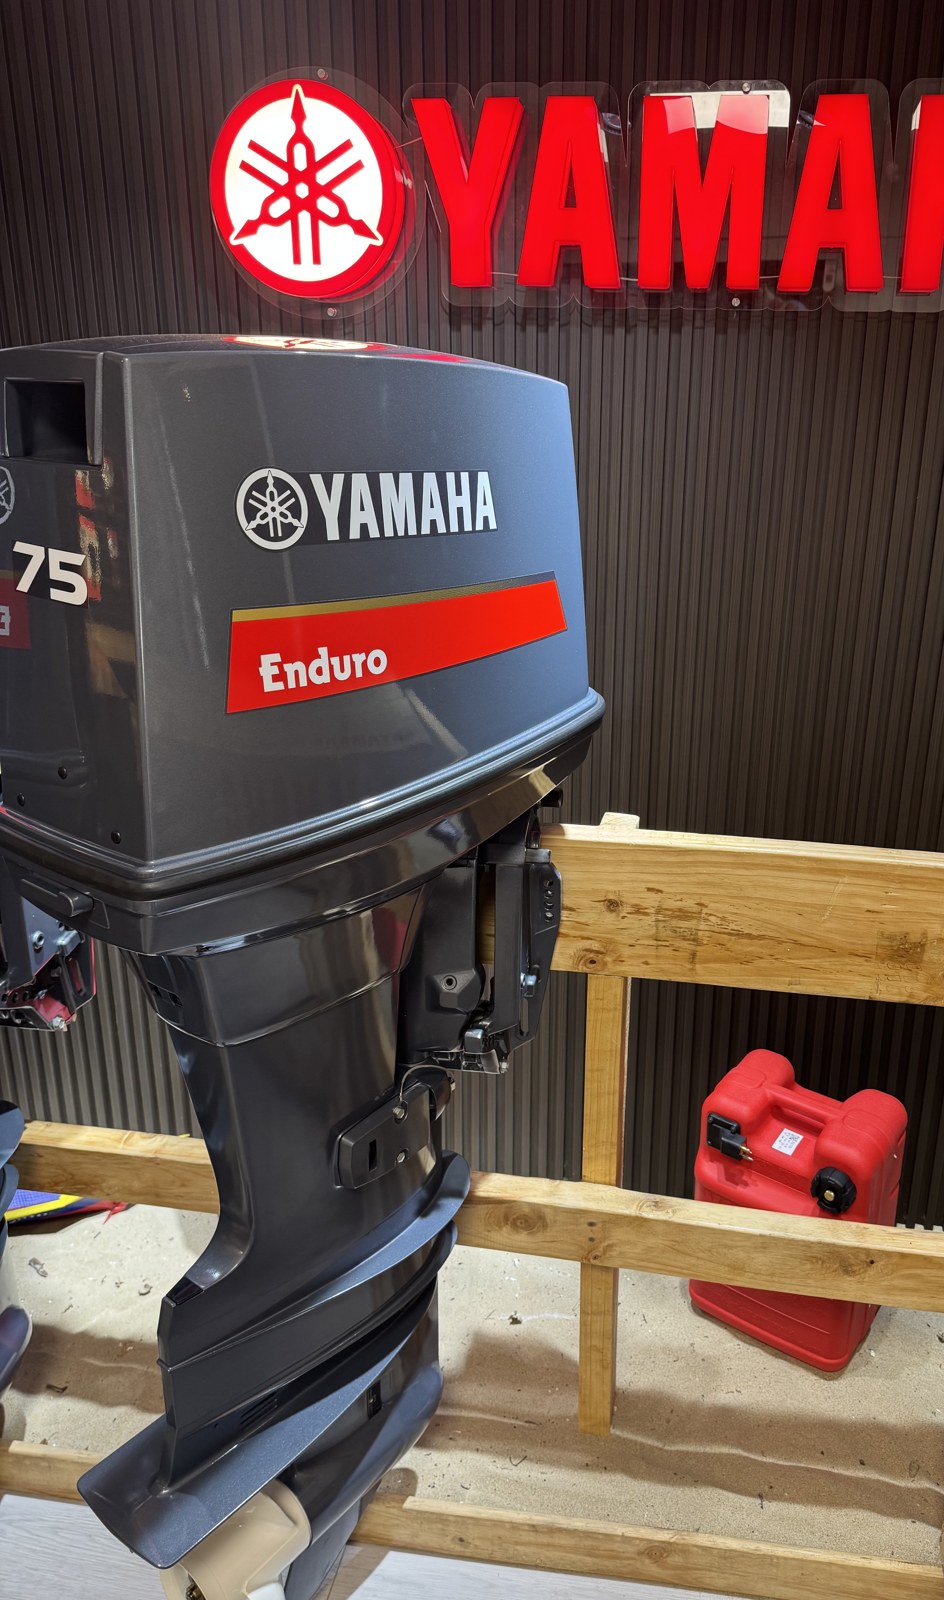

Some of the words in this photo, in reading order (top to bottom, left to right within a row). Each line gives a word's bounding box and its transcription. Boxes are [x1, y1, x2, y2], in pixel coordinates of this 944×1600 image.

[310, 471, 497, 541] YAMAHA
[13, 541, 88, 605] 75
[259, 646, 388, 693] Enduro
